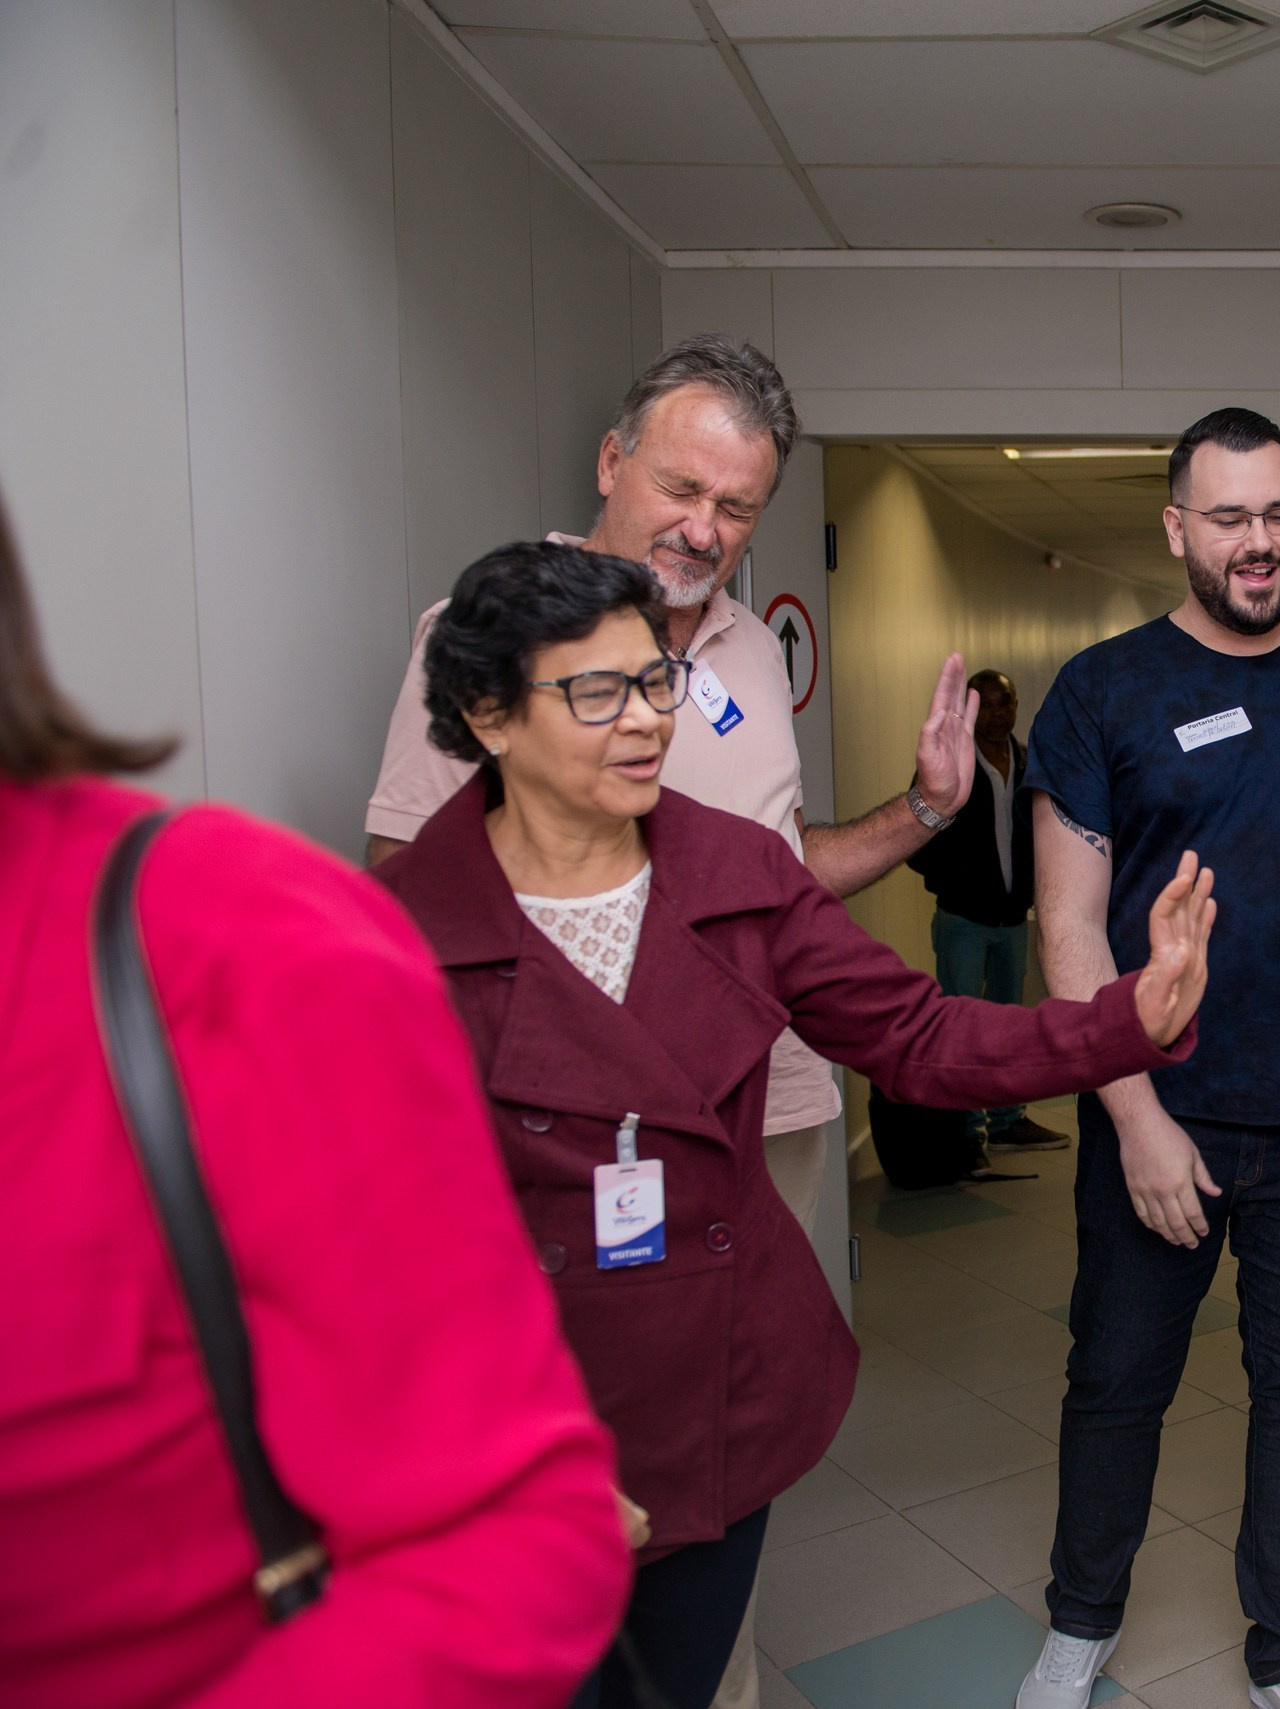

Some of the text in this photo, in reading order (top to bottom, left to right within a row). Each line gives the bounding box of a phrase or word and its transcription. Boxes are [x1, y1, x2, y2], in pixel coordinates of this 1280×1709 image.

[1187, 710, 1239, 730] Portaria Central
[608, 1246, 653, 1261] VISITANTE
